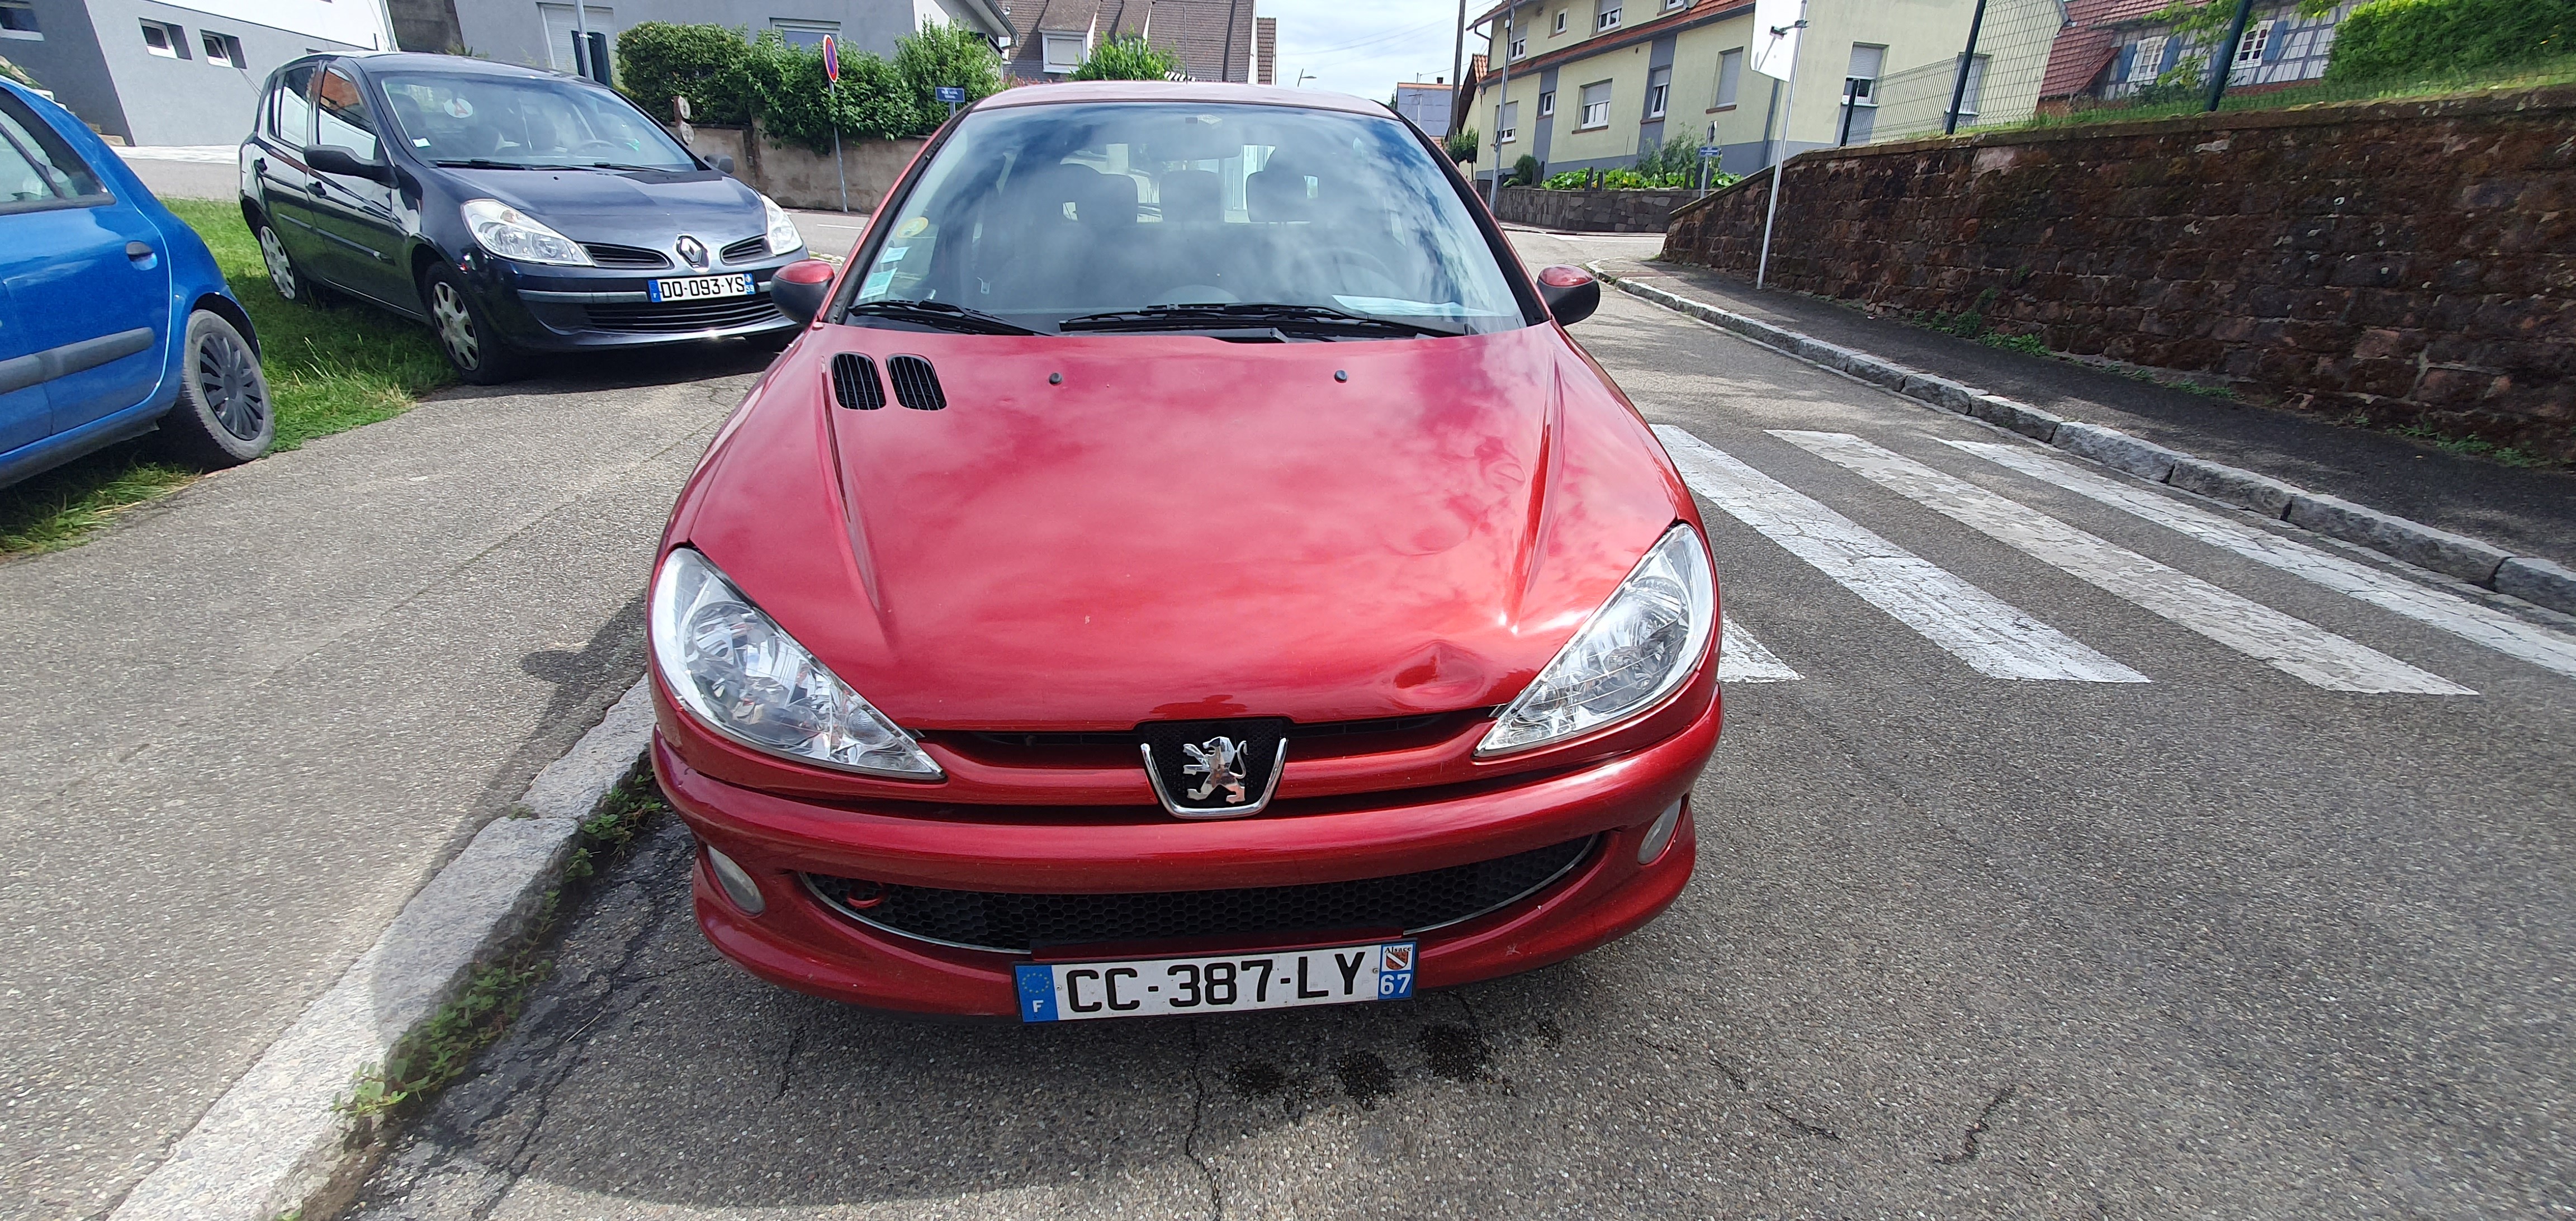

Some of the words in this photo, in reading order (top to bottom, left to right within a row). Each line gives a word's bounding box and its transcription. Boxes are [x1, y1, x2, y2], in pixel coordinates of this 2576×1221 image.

[1066, 952, 1366, 1012] CC-387-LY
[1380, 973, 1411, 995] 67
[1033, 1000, 1044, 1013] F
